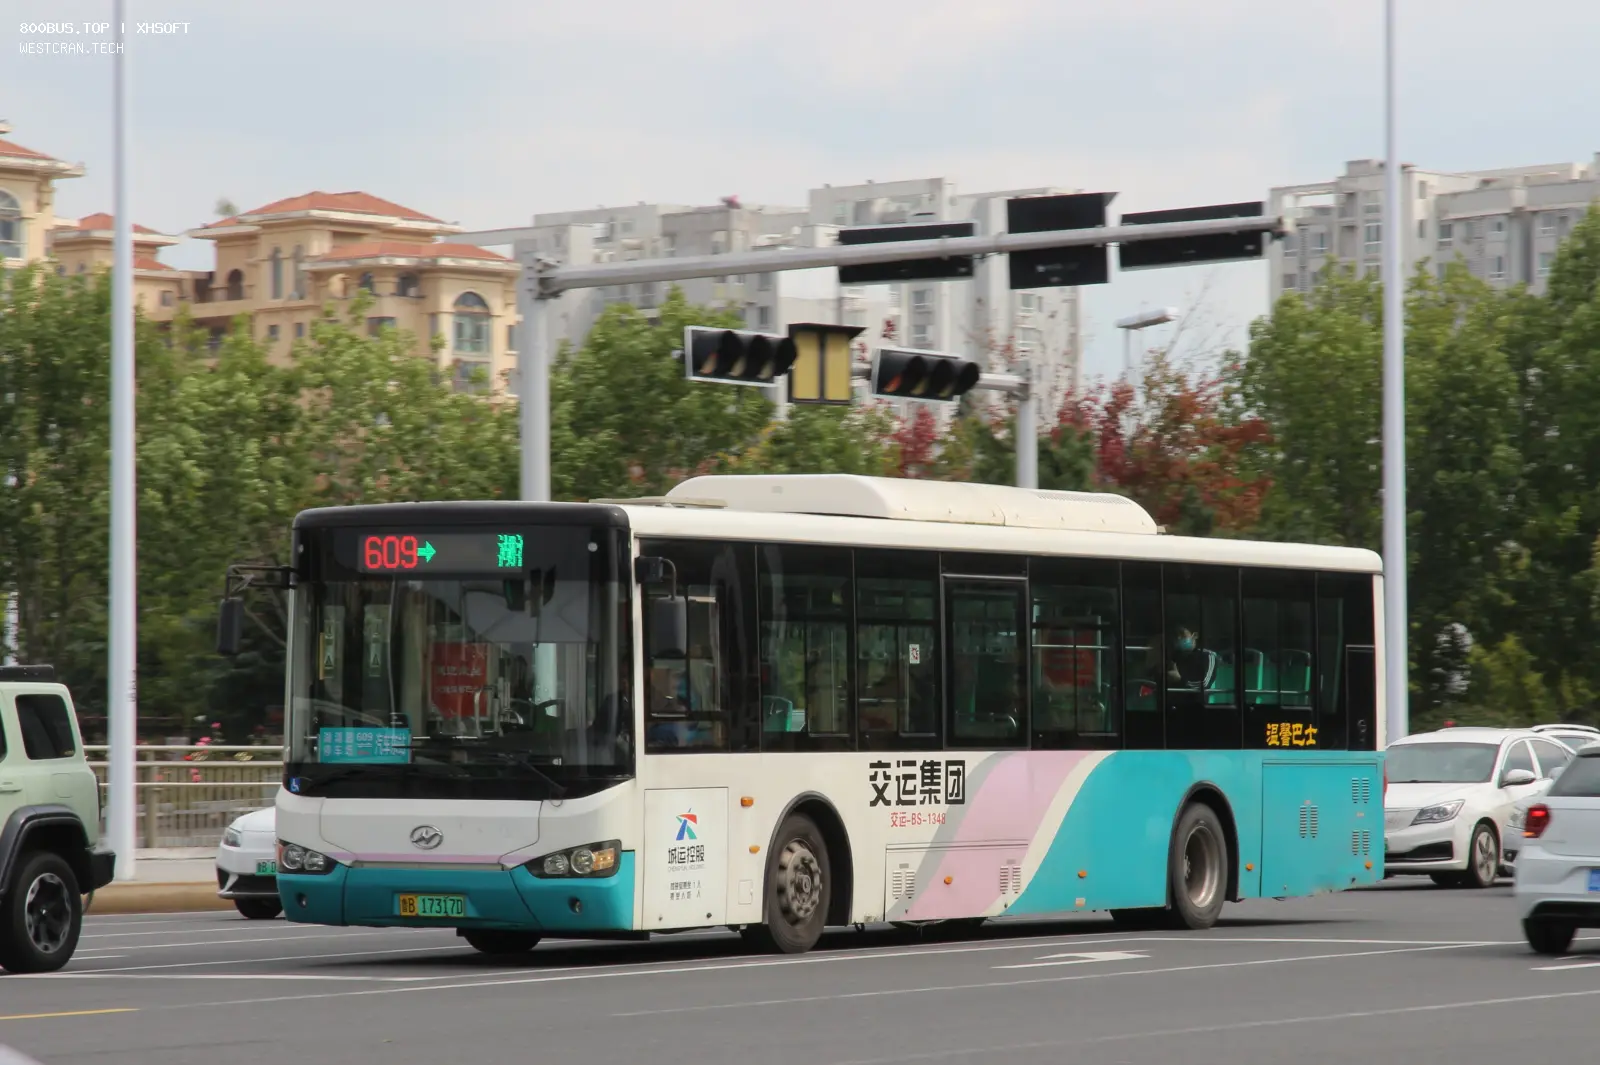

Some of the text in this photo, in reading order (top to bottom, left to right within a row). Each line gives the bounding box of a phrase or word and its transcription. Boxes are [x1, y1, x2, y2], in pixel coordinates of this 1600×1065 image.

[365, 535, 418, 569] 609
[357, 732, 373, 742] 609
[1266, 722, 1318, 746] 温馨巴士
[869, 760, 966, 807] 交运集团
[890, 811, 946, 828] 交运-BS-1348
[668, 844, 705, 865] 城运控股
[421, 898, 463, 915] 17317D
